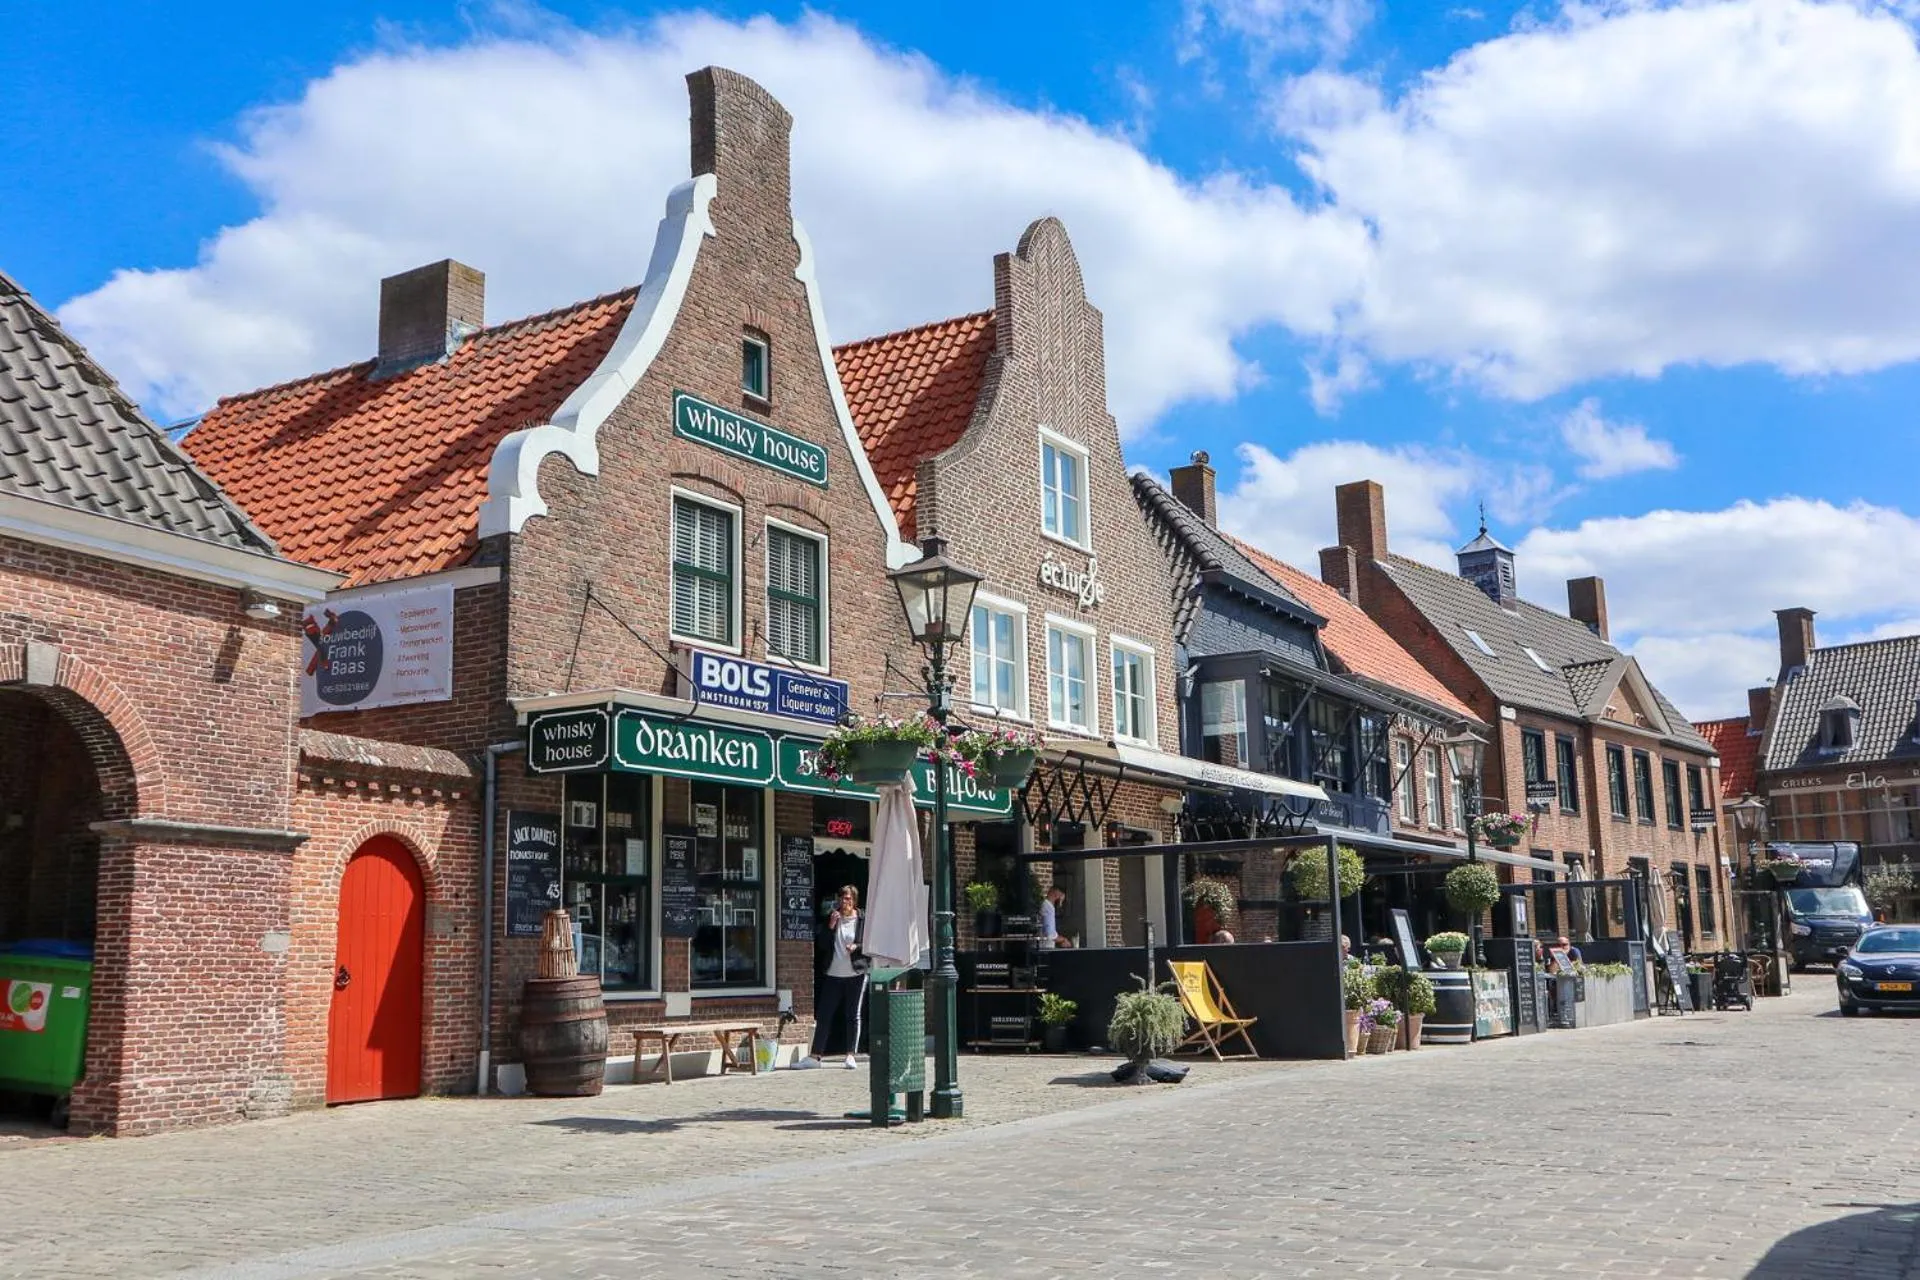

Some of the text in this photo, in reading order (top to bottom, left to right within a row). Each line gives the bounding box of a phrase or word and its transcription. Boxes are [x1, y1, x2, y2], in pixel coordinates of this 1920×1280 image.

[687, 406, 820, 473] whisky house
[327, 641, 366, 660] Frank
[331, 660, 366, 676] Baas
[701, 657, 770, 698] BOLS
[700, 690, 751, 708] AMSTERDAM
[787, 680, 822, 699] Genever
[781, 694, 836, 717] Liqueur store
[542, 721, 596, 742] whisky
[545, 744, 593, 762] house
[1782, 778, 1822, 788] GRIEKS
[513, 826, 530, 846] JACK
[827, 820, 852, 835] OPEN
[546, 883, 561, 899] 43
